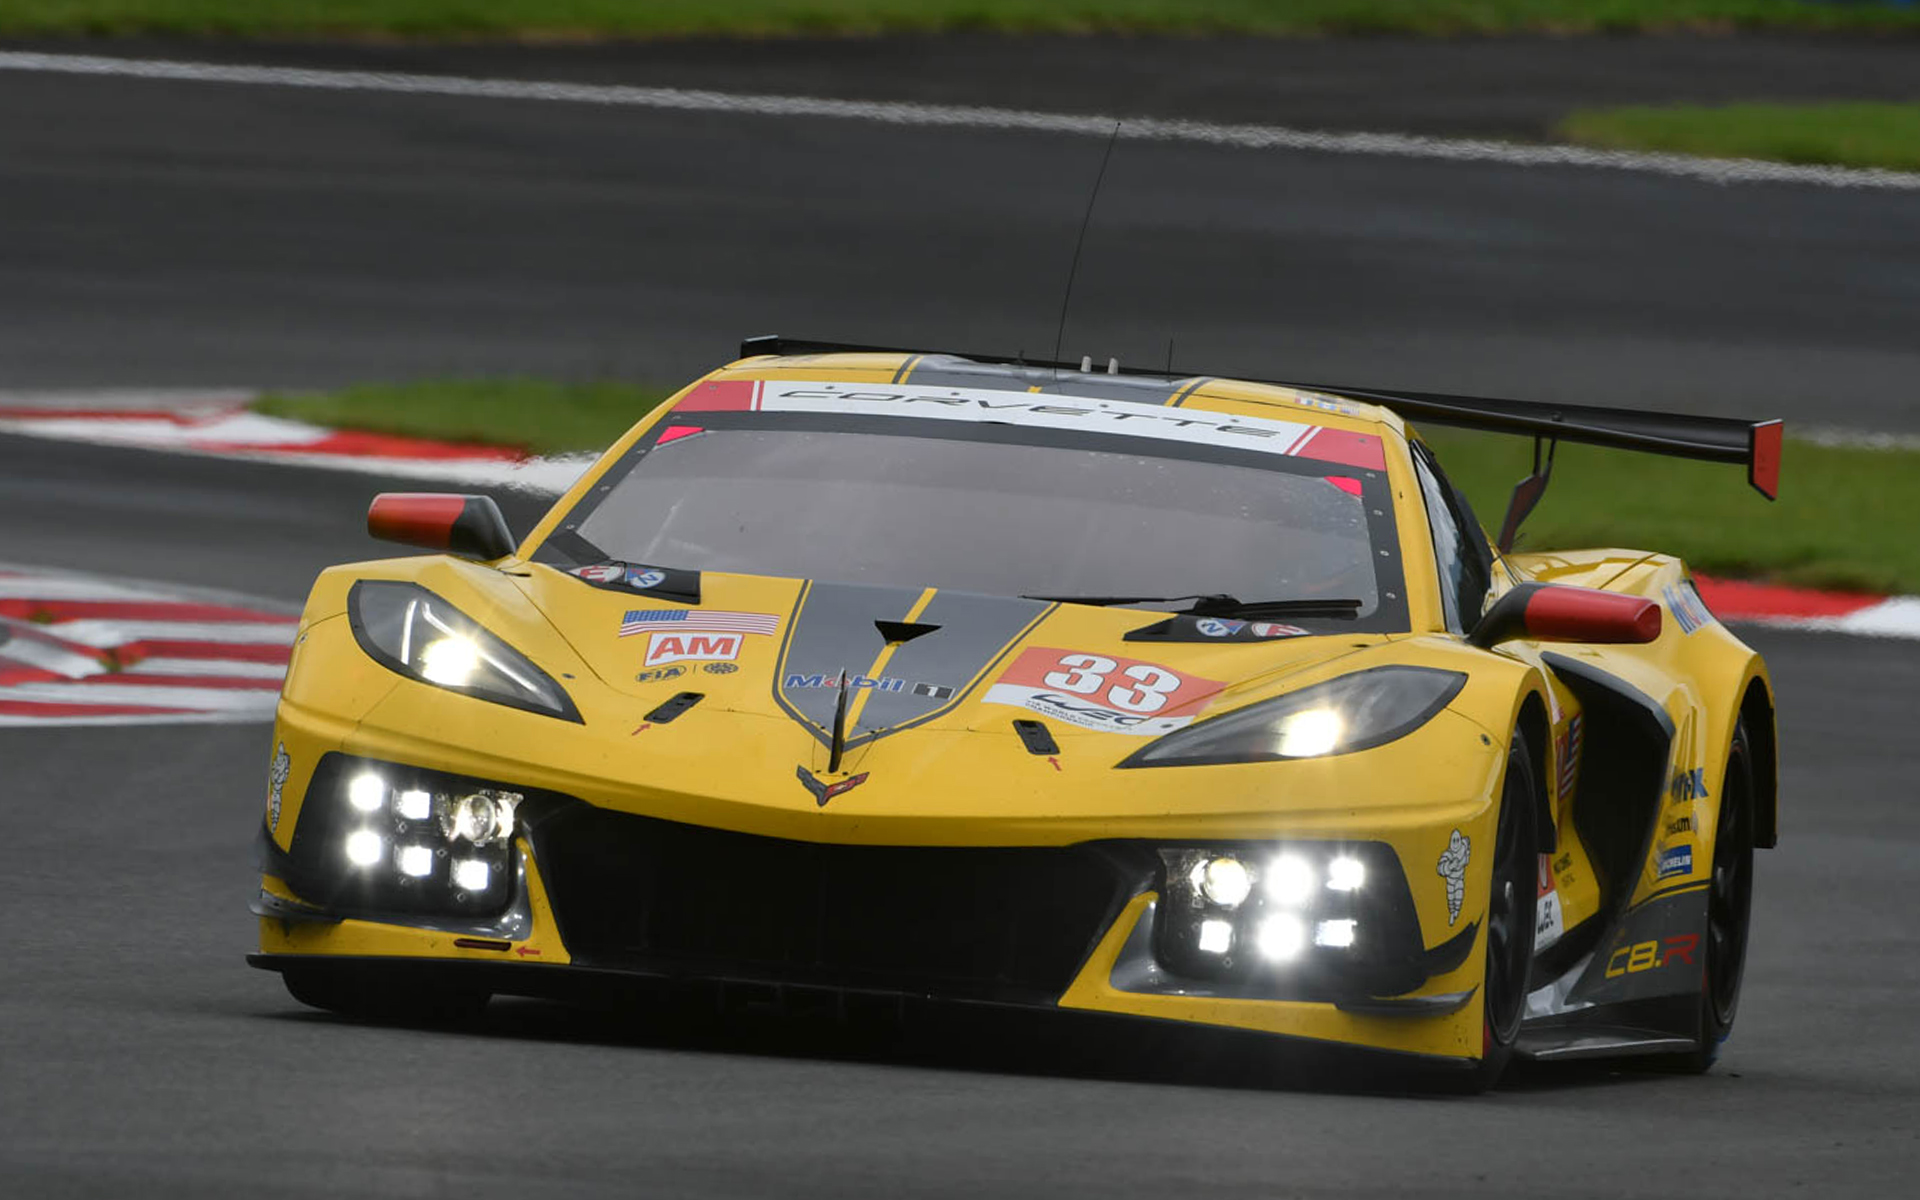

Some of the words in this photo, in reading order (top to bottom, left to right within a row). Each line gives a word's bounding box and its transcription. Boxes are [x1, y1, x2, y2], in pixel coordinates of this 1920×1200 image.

[778, 389, 1281, 438] CORVETTE
[649, 636, 737, 660] AM
[638, 667, 681, 682] FIA
[784, 674, 905, 692] Mobil
[1043, 653, 1182, 713] 33
[1604, 933, 1699, 978] C8.R
